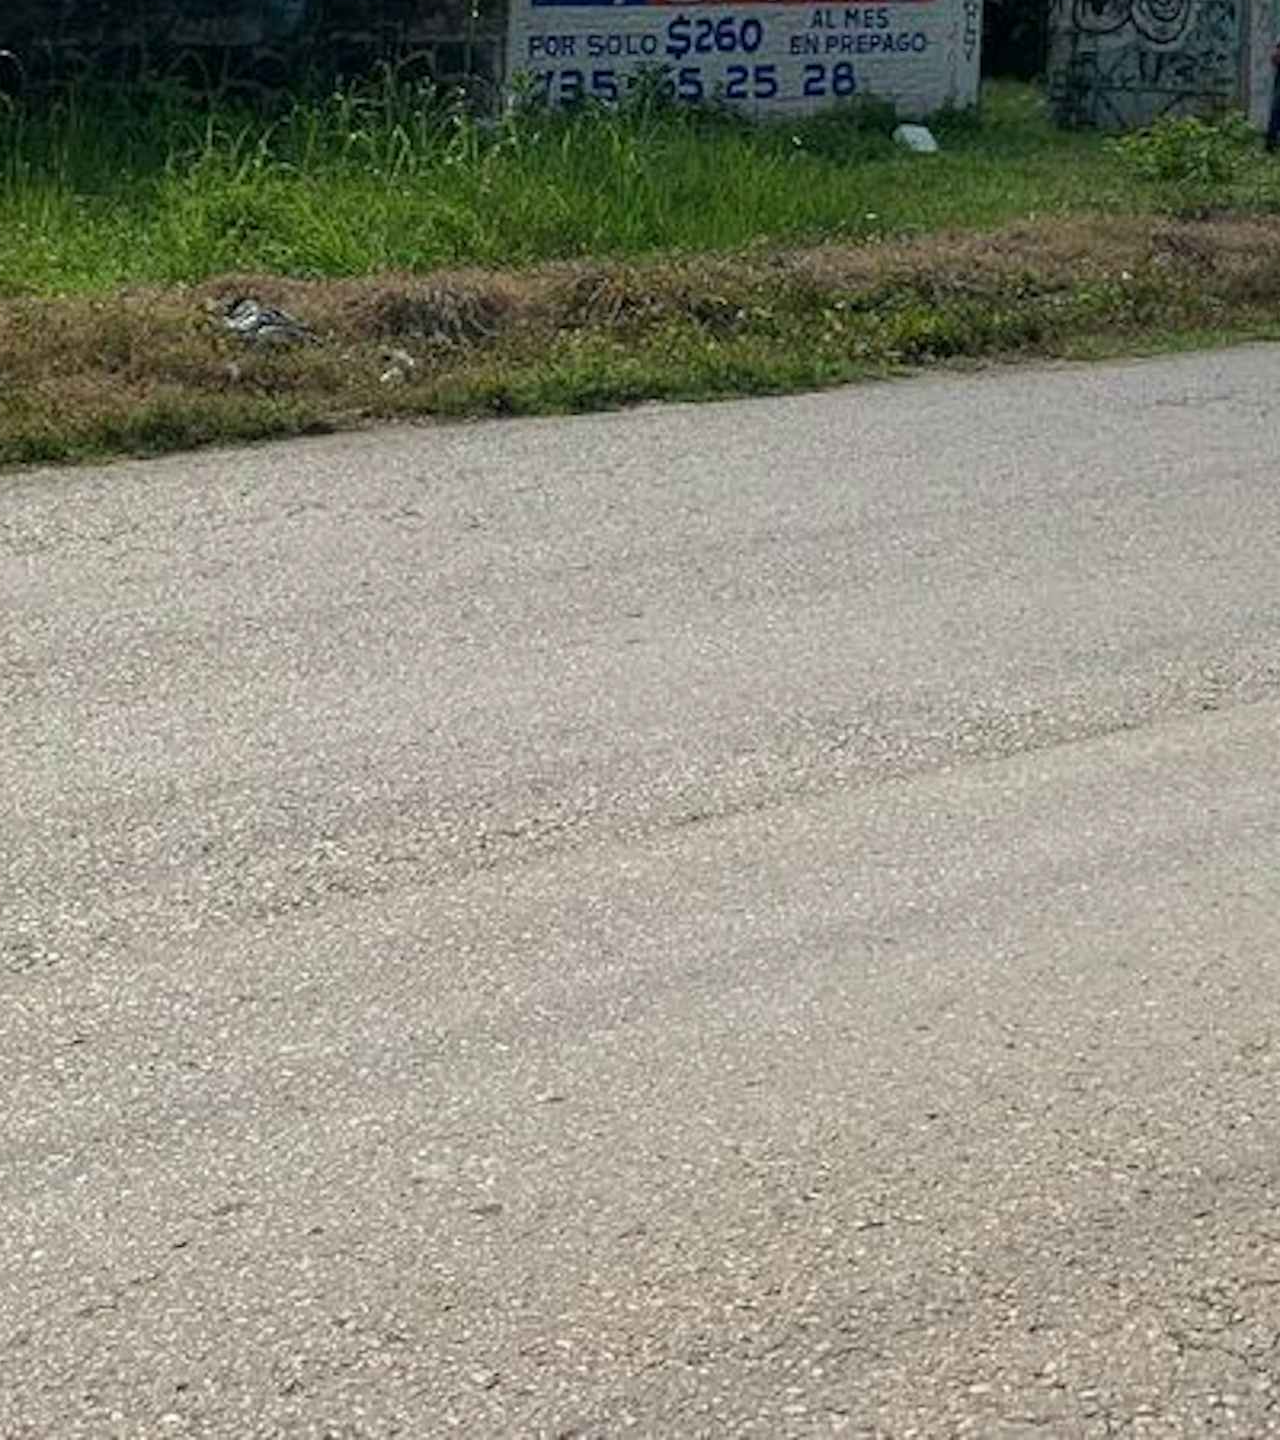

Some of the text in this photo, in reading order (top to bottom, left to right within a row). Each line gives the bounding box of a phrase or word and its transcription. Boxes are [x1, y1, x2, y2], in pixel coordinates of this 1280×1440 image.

[810, 8, 890, 30] AL MES
[528, 13, 763, 61] POR SOLO $260
[789, 32, 928, 56] EN PREPAGO
[725, 64, 778, 100] 25
[802, 60, 857, 97] 28
